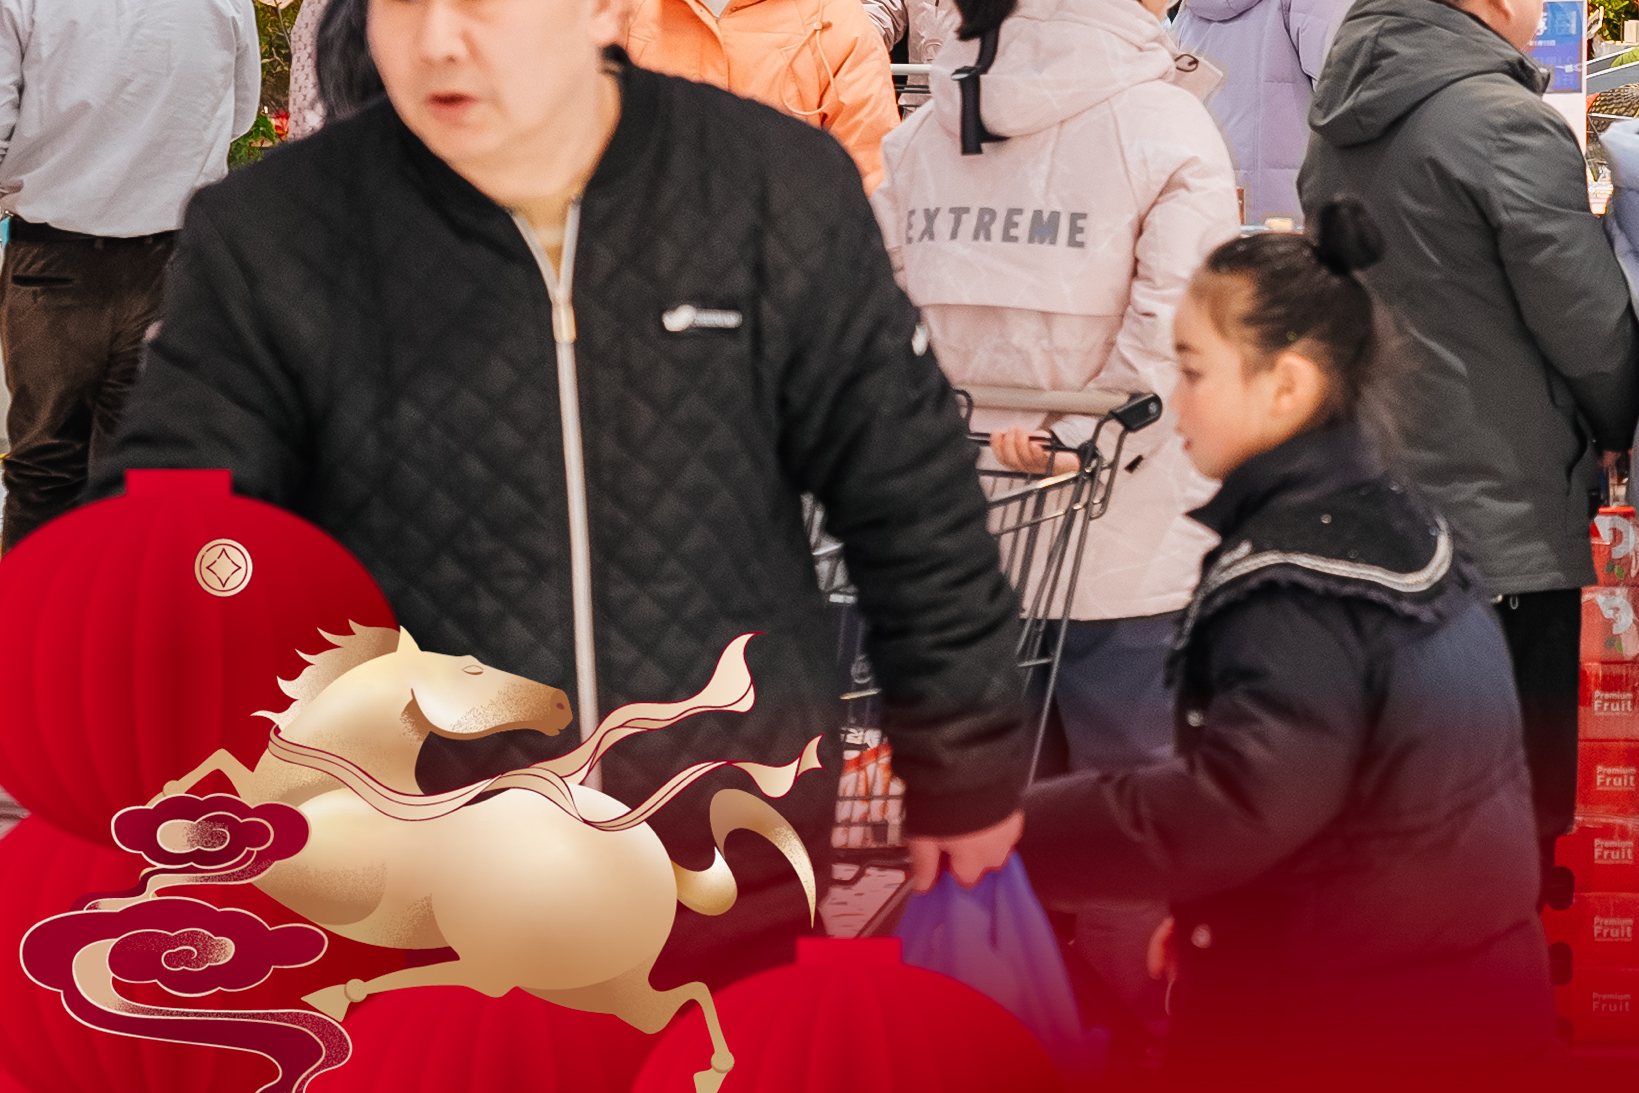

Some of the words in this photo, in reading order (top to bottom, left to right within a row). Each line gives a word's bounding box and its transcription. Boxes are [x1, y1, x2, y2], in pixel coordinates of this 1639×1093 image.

[904, 206, 1088, 249] EXTREME
[1593, 690, 1633, 701] Premium
[1593, 699, 1633, 713] Fruit
[1596, 765, 1636, 775] Premium
[1596, 774, 1636, 788] Fruit
[1593, 838, 1634, 849] Premium
[1593, 847, 1633, 861] Fruit
[1593, 915, 1633, 926] Premium
[1593, 925, 1633, 939] Fruit
